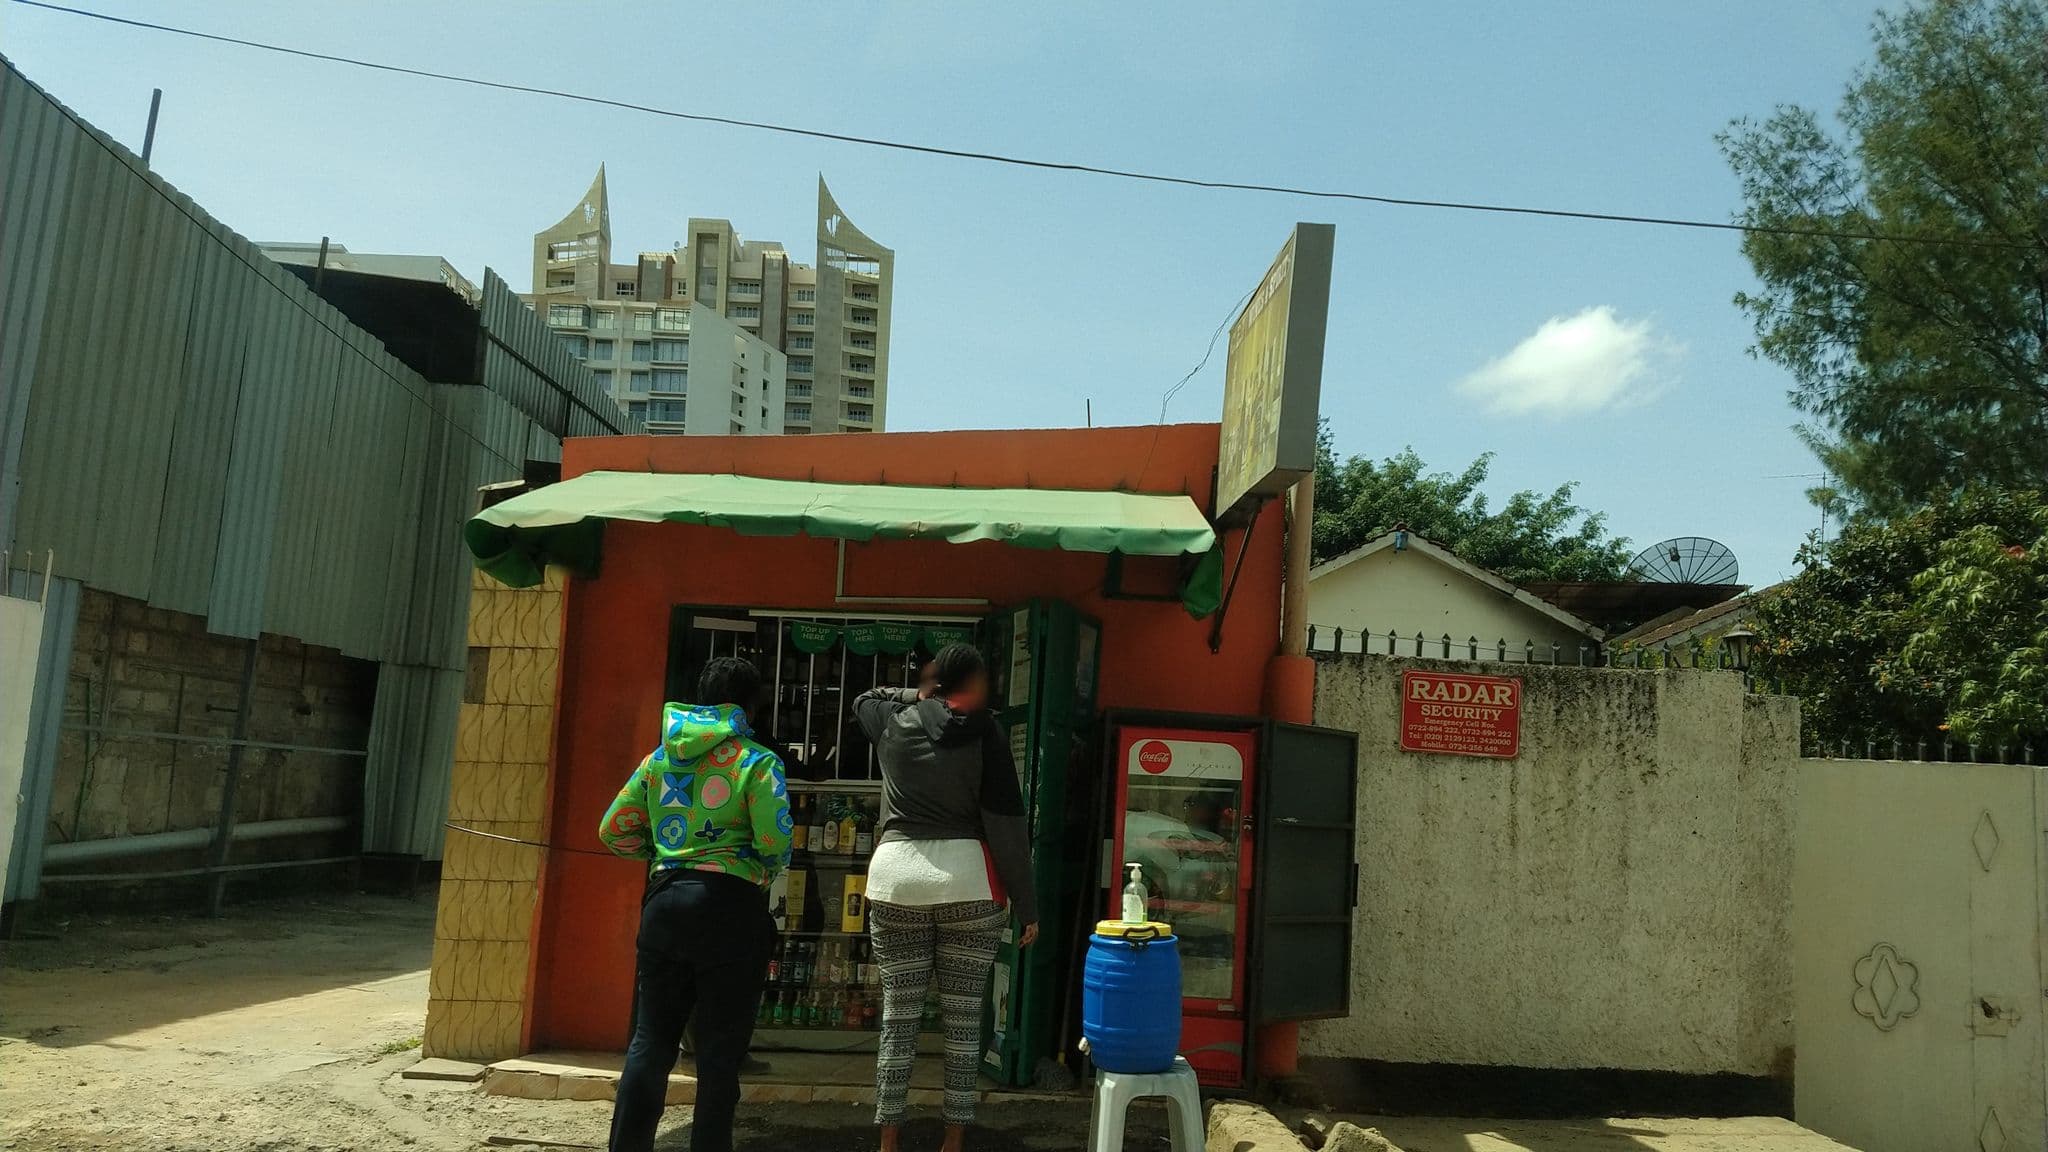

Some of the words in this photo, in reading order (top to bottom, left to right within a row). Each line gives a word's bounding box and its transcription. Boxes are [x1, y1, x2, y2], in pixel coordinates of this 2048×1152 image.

[803, 633, 825, 641] HERE
[884, 633, 907, 641] HERE
[1410, 680, 1513, 706] RADAR
[1421, 704, 1502, 721] SECURITY
[1424, 718, 1464, 728] Emergency
[1424, 733, 1442, 741] (020)
